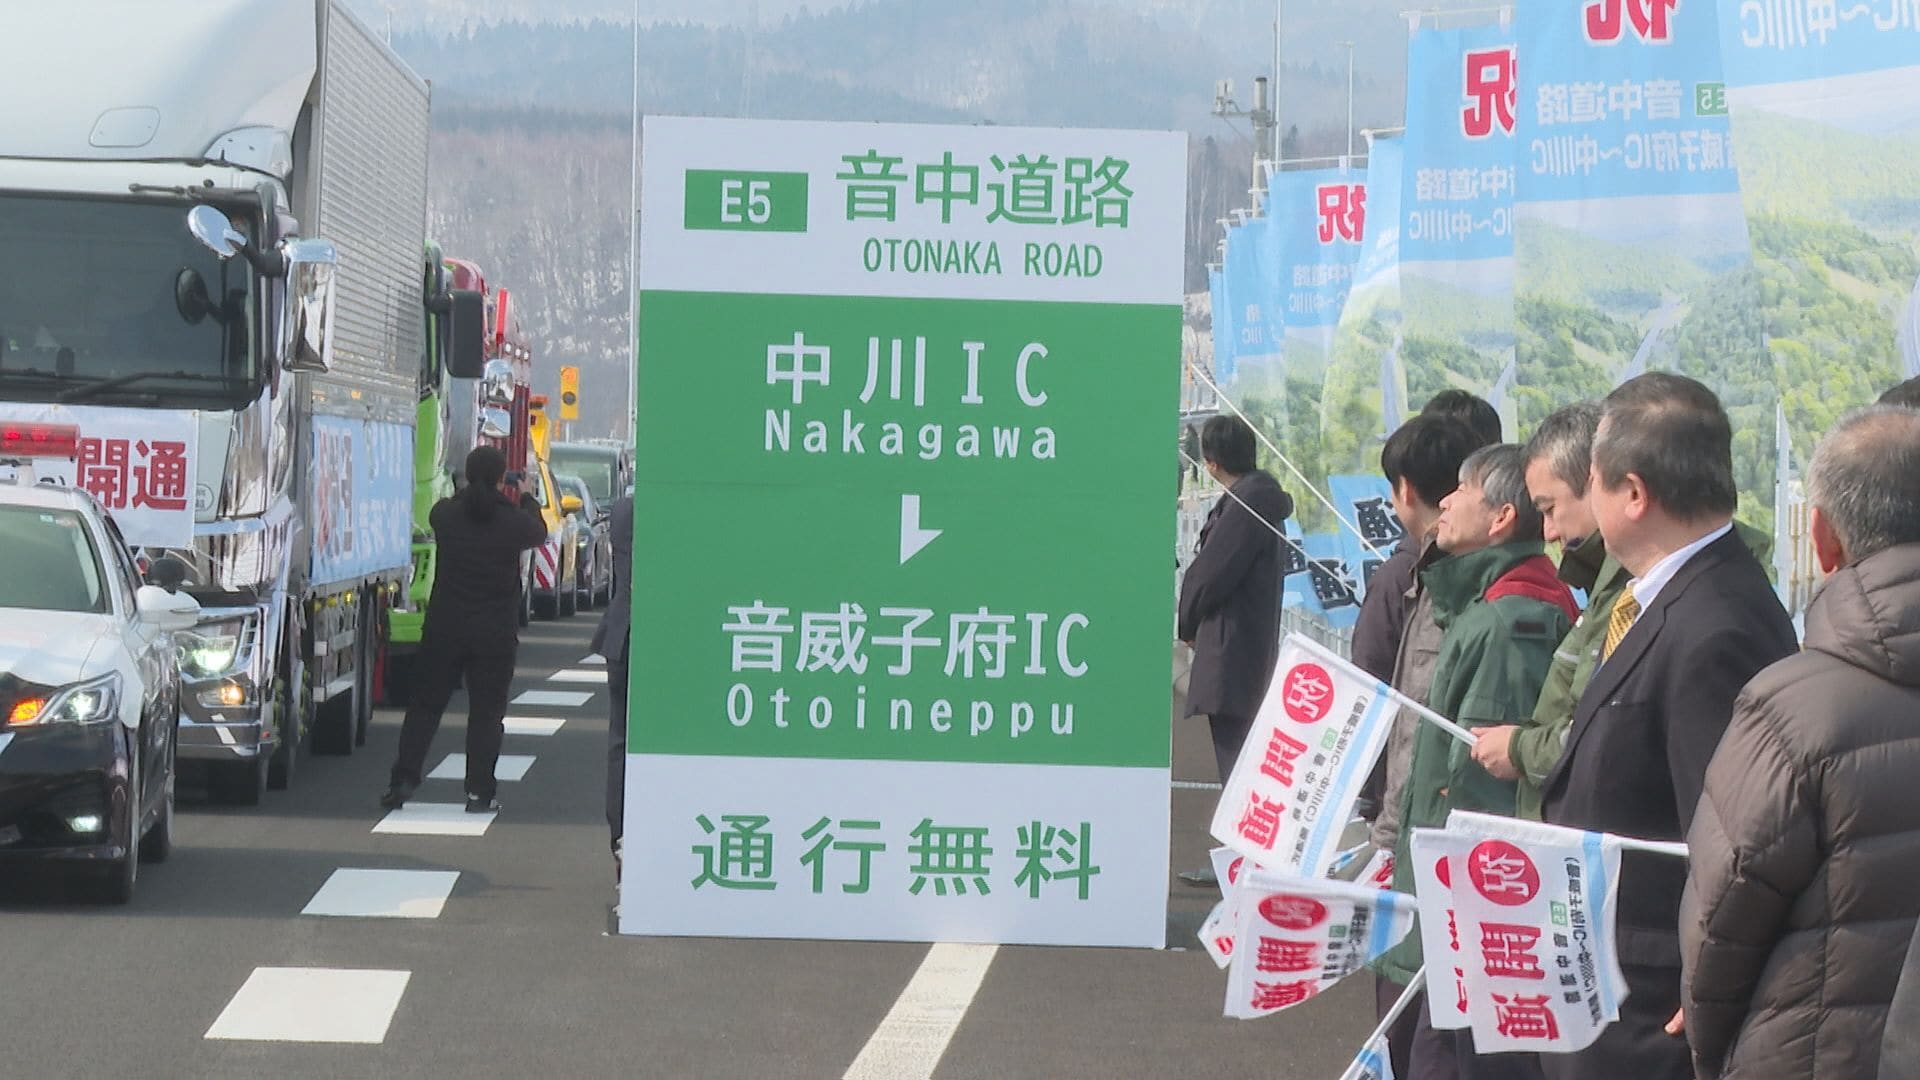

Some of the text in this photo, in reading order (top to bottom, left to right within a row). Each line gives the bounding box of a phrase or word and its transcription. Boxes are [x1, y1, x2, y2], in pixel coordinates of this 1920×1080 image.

[720, 149, 1134, 229] E5 音中道路
[863, 238, 1103, 277] OTONAKA ROAD
[766, 331, 1049, 407] 中川IC
[765, 409, 1056, 460] Nakagawa
[77, 437, 187, 511] 開通
[722, 600, 1090, 678] 音威子府IC
[726, 683, 1074, 737] Otoineppu
[691, 814, 1101, 901] 通行無料
